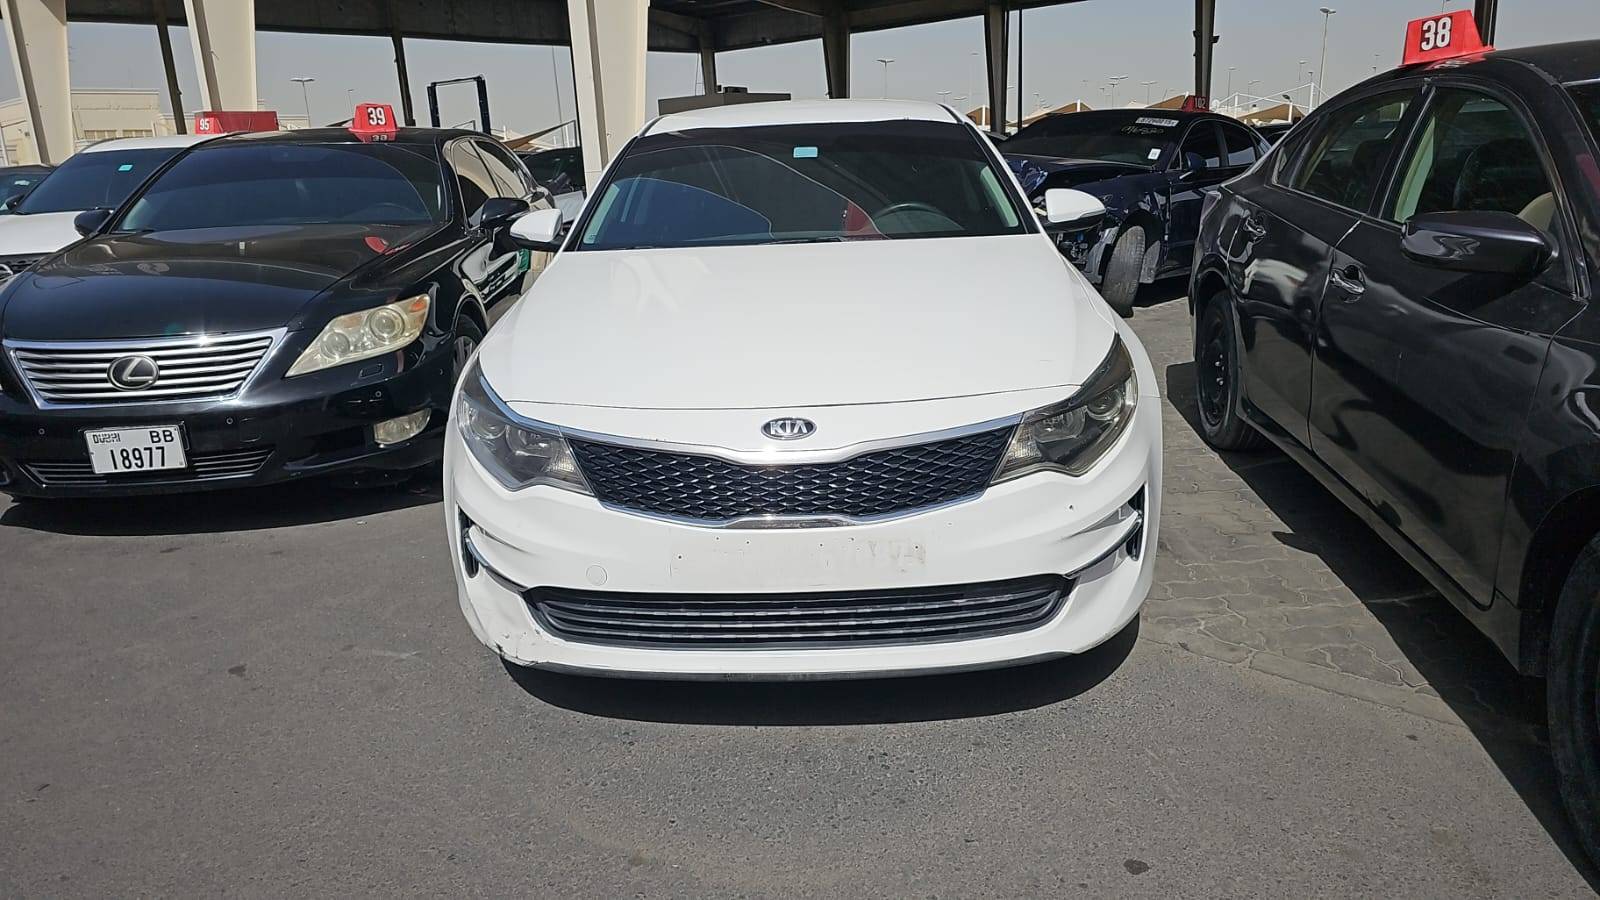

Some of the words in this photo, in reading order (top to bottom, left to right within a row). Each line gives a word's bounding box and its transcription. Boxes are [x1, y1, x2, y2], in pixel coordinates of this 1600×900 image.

[1421, 16, 1452, 51] 38
[199, 117, 210, 131] 95
[367, 107, 386, 126] 39
[149, 429, 174, 443] BB
[770, 420, 808, 435] KIA
[110, 446, 165, 470] 18977
